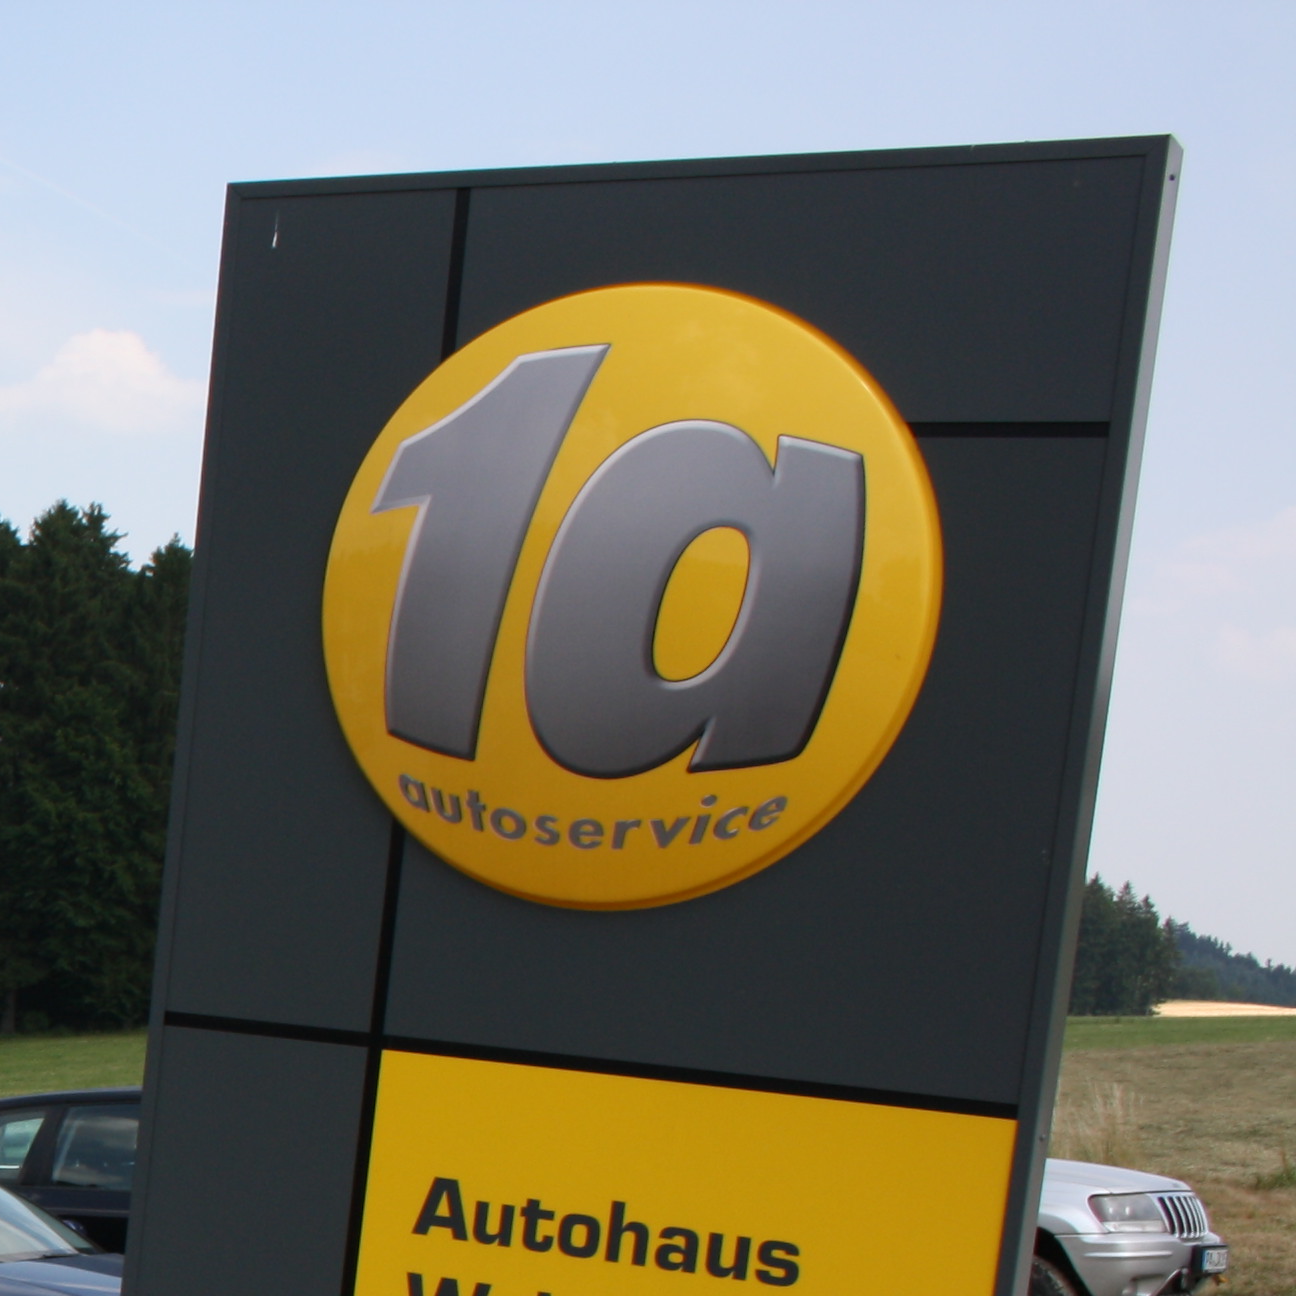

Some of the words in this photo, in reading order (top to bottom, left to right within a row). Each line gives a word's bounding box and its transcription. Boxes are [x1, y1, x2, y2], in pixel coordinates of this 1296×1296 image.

[371, 343, 866, 779] 1a
[398, 773, 788, 850] autoservice
[411, 1176, 801, 1287] Autohaus
